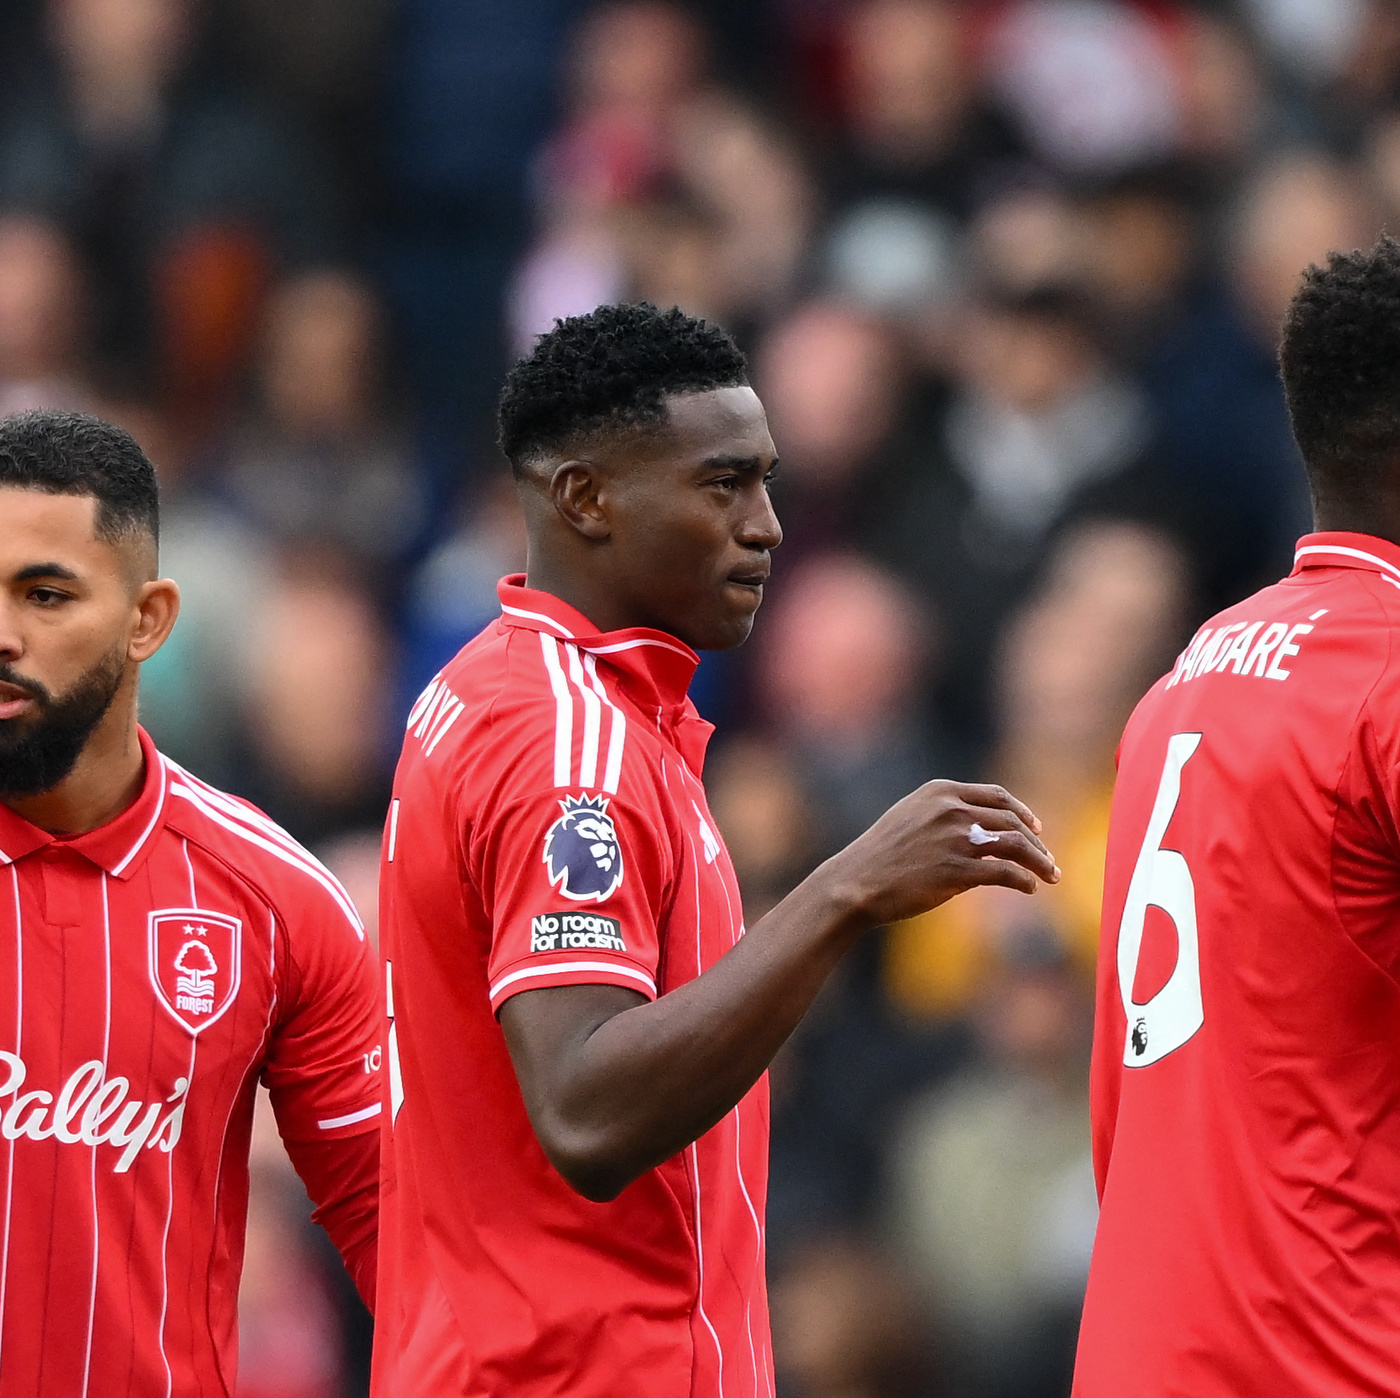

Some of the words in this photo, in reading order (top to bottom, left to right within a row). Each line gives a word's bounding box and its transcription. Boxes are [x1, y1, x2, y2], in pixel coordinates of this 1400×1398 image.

[1116, 732, 1205, 1069] 6
[531, 915, 560, 934] No
[562, 916, 615, 935] room
[530, 932, 559, 952] for
[561, 932, 627, 952] racism
